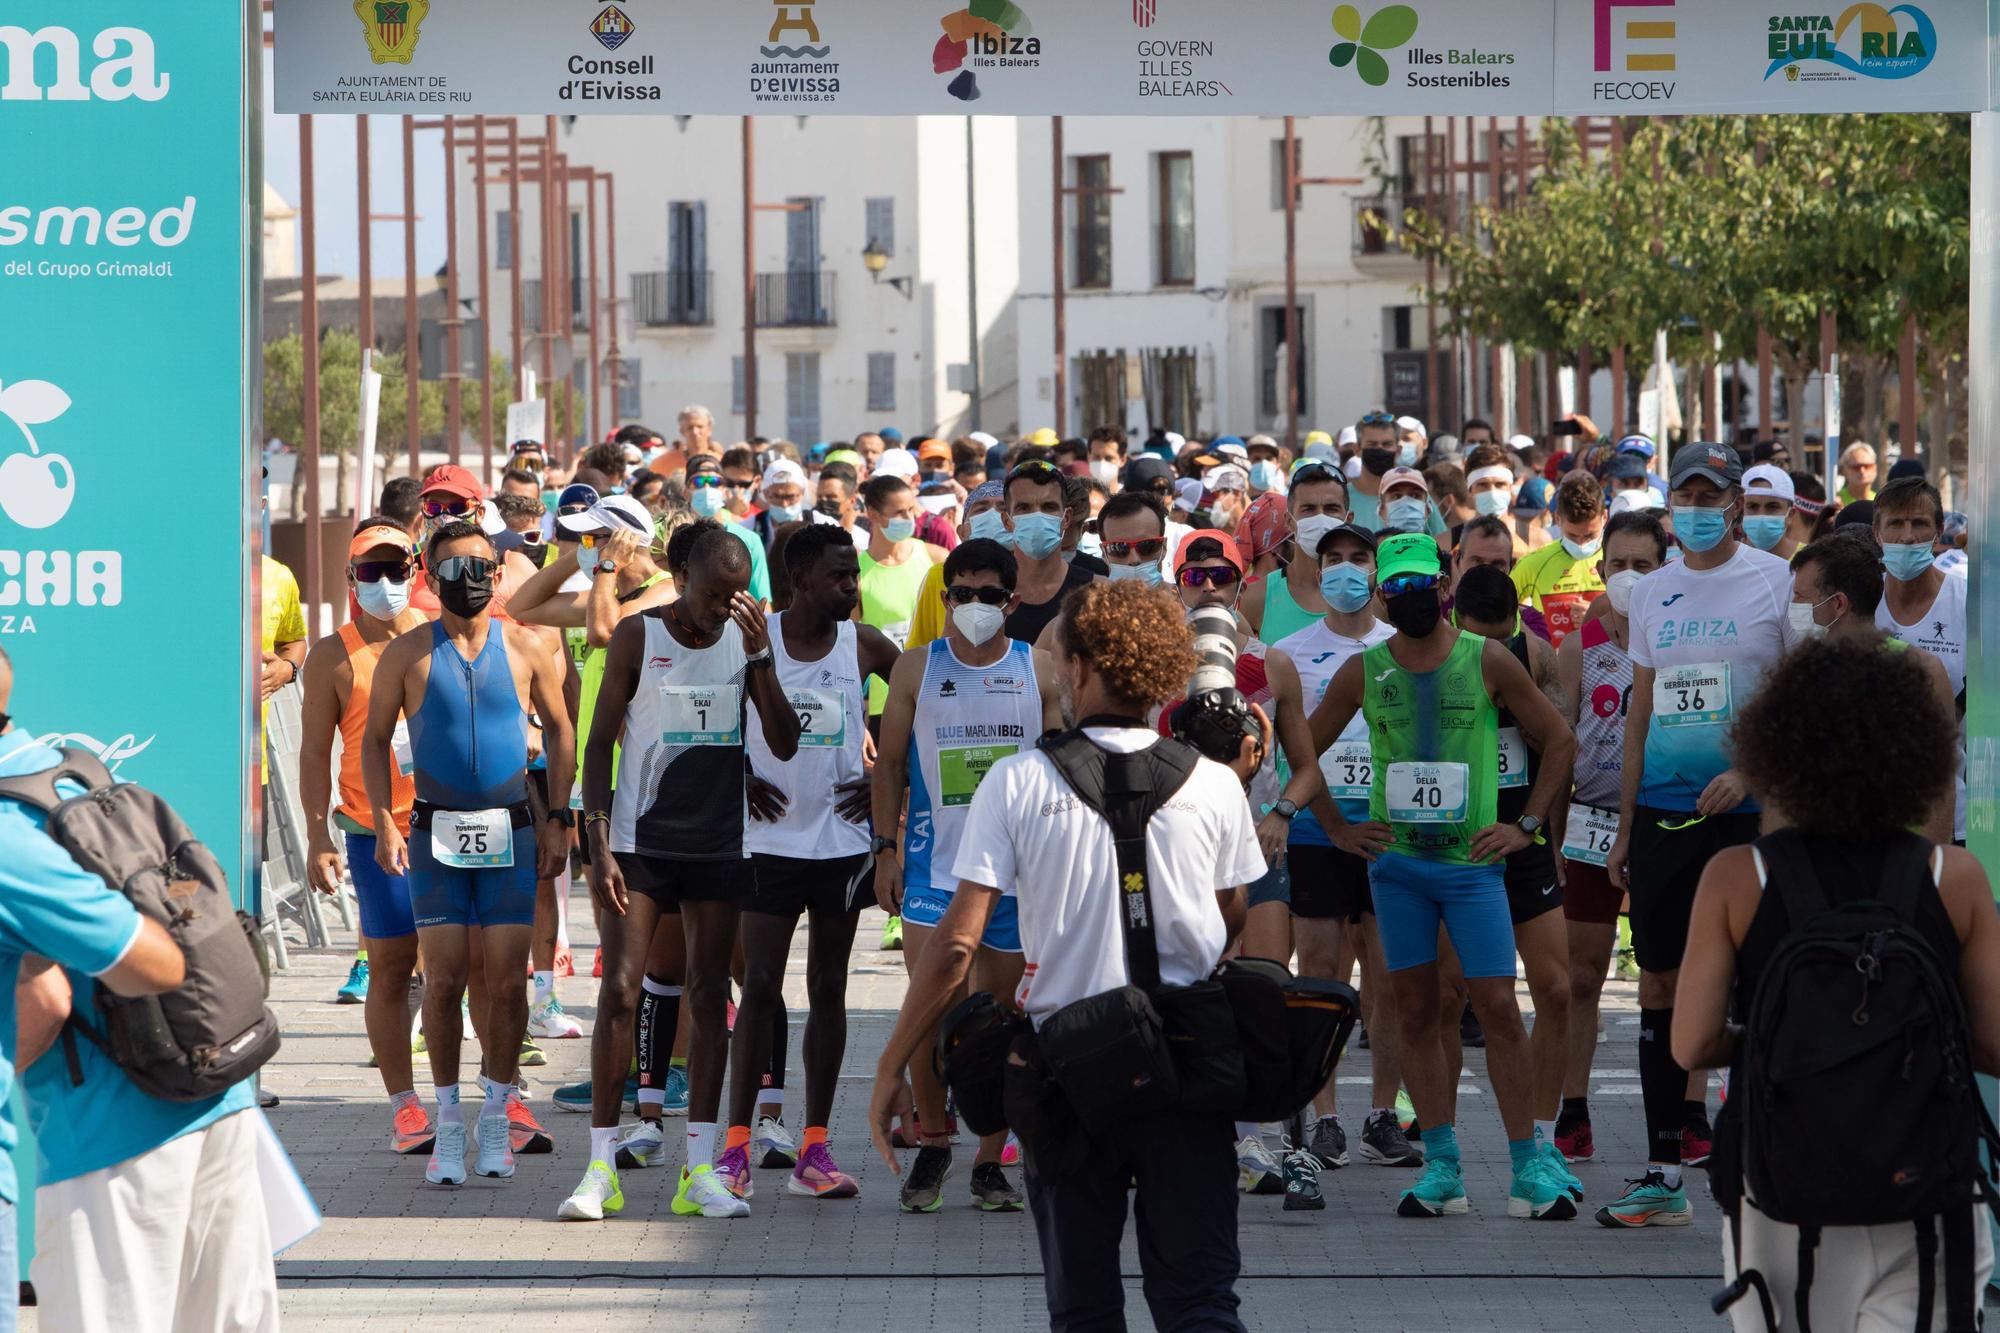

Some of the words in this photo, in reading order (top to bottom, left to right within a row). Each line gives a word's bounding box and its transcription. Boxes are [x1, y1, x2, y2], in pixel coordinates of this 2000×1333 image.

[1768, 16, 1834, 32] SANTA
[974, 32, 1041, 55] Ibiza
[1138, 41, 1213, 57] GOVERN
[567, 55, 654, 75] Consell
[974, 58, 996, 67] Illes
[1000, 58, 1040, 67] Balears
[1408, 49, 1443, 65] Illes
[1448, 49, 1515, 65] Balears
[1140, 62, 1193, 77] ILLES
[337, 77, 426, 87] AJUNTAMENT
[429, 77, 447, 87] DE
[1407, 72, 1511, 88] Sostenibles
[313, 91, 357, 102] SANTA
[359, 89, 416, 102] EULÀRIA
[419, 90, 447, 102] DES
[450, 91, 473, 102] RIU
[559, 81, 662, 100] d'Eivissa
[1138, 82, 1219, 97] BALEARS
[1593, 82, 1675, 100] FECOEV
[756, 94, 835, 102] www.eivissa.es
[0, 195, 197, 247] smed
[4, 261, 33, 276] del
[38, 261, 91, 279] Grupo
[96, 261, 173, 277] Grimaldi
[1, 616, 37, 633] ZA
[1680, 620, 1738, 638] IBIZA
[1664, 679, 1691, 689] GERBEN
[1692, 678, 1719, 687] EVERTS
[694, 699, 712, 708] EKAI
[1677, 688, 1705, 711] 36
[697, 709, 707, 731] 1
[800, 712, 812, 734] 2
[936, 726, 963, 740] BLUE
[965, 725, 996, 738] MARLIN
[998, 724, 1025, 739] IBIZA
[973, 749, 993, 757] IBIZA
[1335, 755, 1358, 763] JORGE
[966, 760, 993, 769] AVEIRO
[1343, 764, 1371, 785] 32
[1416, 777, 1438, 785] DELIA
[1411, 786, 1442, 808] 40
[455, 823, 489, 832] Yosbanny
[458, 832, 488, 854] 25
[1588, 830, 1611, 852] 16
